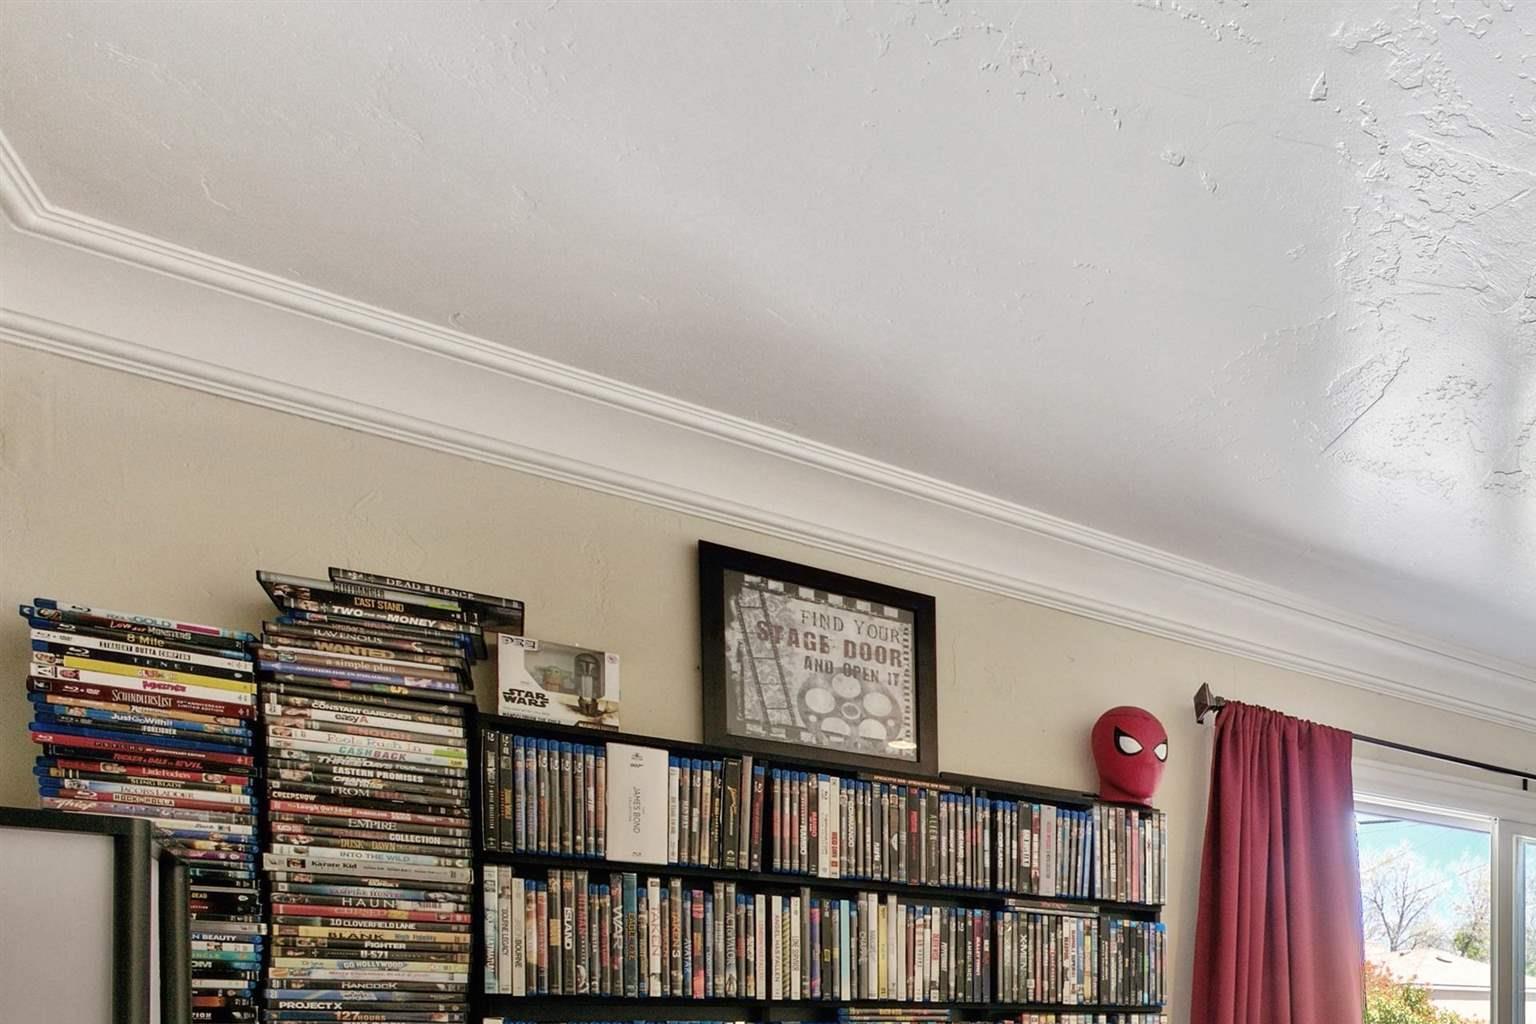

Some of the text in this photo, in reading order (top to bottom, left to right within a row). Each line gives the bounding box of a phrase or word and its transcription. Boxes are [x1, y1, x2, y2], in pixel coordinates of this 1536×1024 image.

[386, 578, 475, 600] DEAD SILENCE
[354, 597, 405, 612] LAST STAND
[333, 606, 437, 627] TWO MONEY
[801, 610, 900, 643] FIND YOUR
[127, 633, 165, 647] 8 Mile
[313, 629, 383, 644] RAVENOUS
[756, 620, 902, 667] STAGE DOOR
[315, 642, 395, 659] WANTED
[334, 660, 371, 673] simple
[373, 663, 395, 675] plan
[804, 656, 900, 686] AND OPEN IT
[339, 746, 406, 760] CASHBACK
[176, 760, 203, 769] EVIL
[333, 767, 423, 783] EASTERN PROMISES
[330, 786, 370, 797] FROM
[632, 786, 641, 834] JAMES BOND
[348, 819, 397, 830] EMPIRE
[389, 833, 440, 845] COLLECTION
[340, 851, 364, 859] INTO
[387, 854, 410, 862] WILD
[311, 860, 341, 869] Karate
[330, 918, 416, 930] 10 CLOVERFIELD LANE
[564, 907, 573, 950] ISLAND
[612, 905, 623, 949] WAR
[328, 932, 384, 941] BLANK
[364, 941, 406, 949] FIGHTER
[355, 961, 402, 969] HOLLYWOOD
[279, 1001, 332, 1010] PROJECT
[335, 1011, 358, 1021] 127
